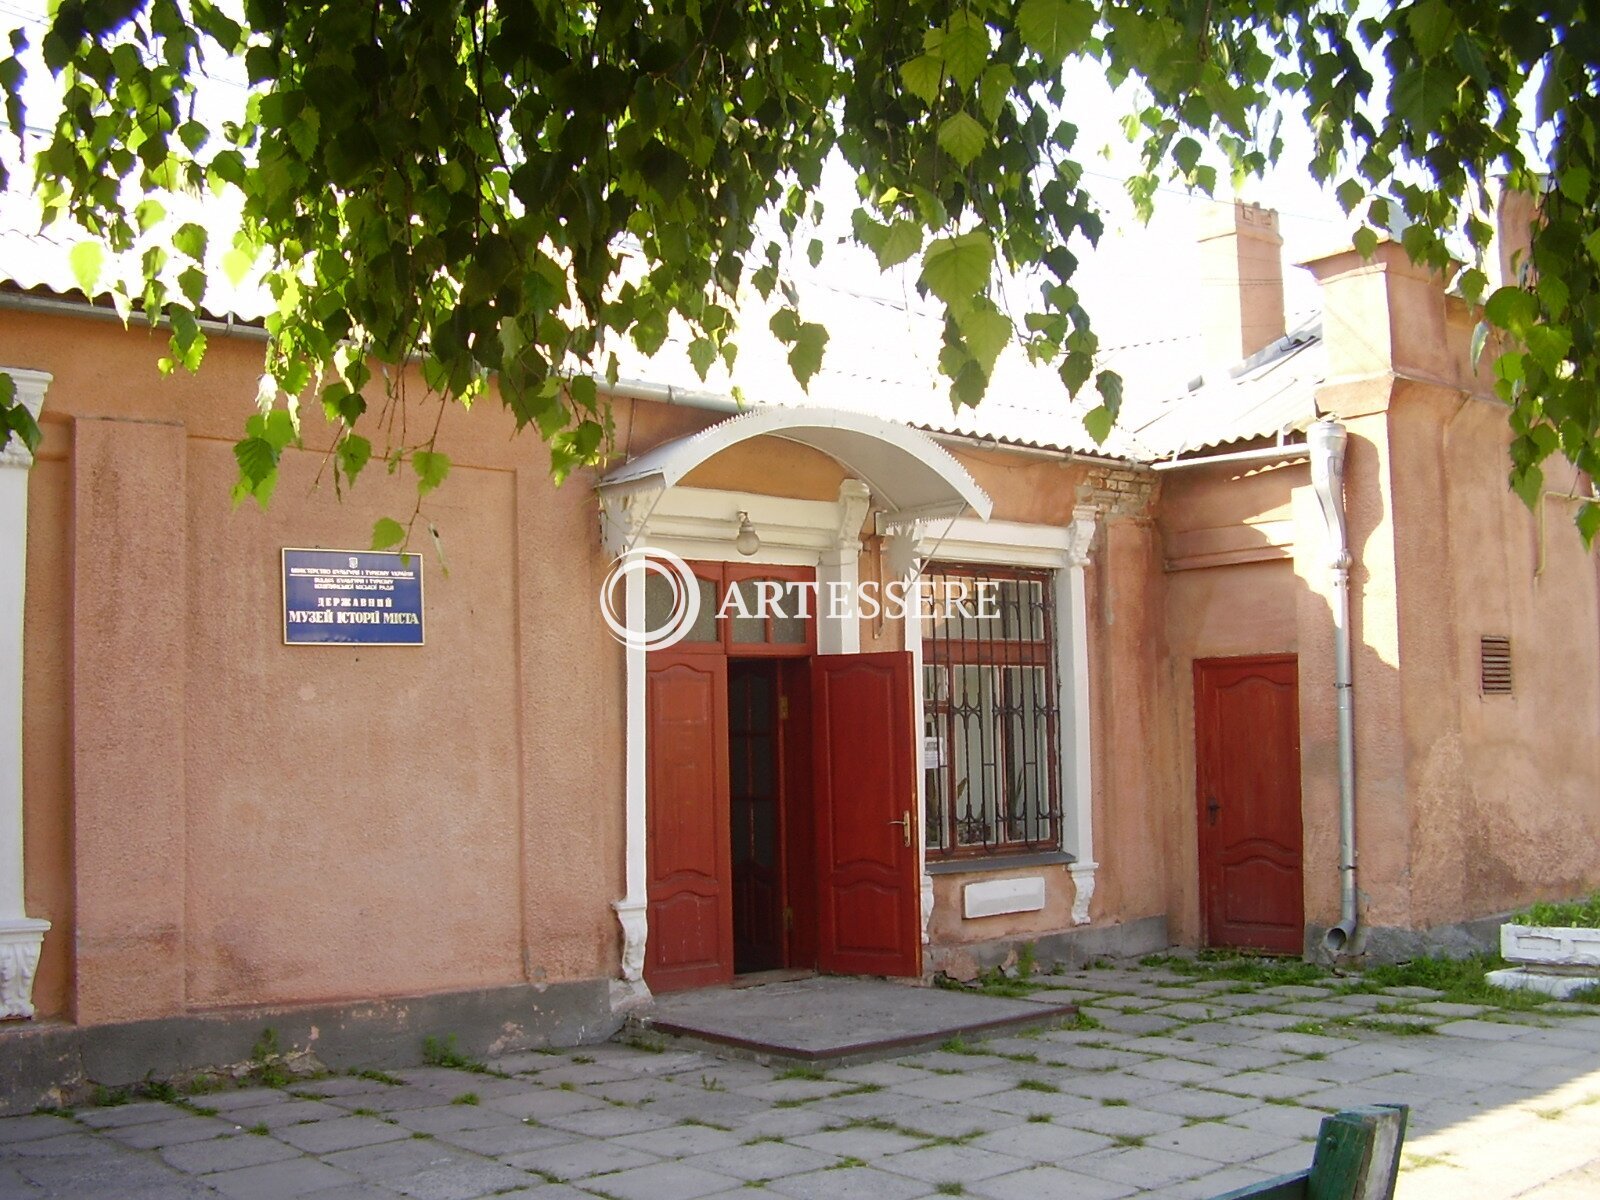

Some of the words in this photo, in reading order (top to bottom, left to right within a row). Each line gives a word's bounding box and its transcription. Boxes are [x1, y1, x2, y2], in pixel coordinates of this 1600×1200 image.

[317, 597, 392, 608] ДЕРЖАВНИЙ
[288, 609, 334, 624] МУЗЕЙ
[336, 610, 380, 624] ІСТОРІЇ
[383, 612, 420, 625] МІСТА
